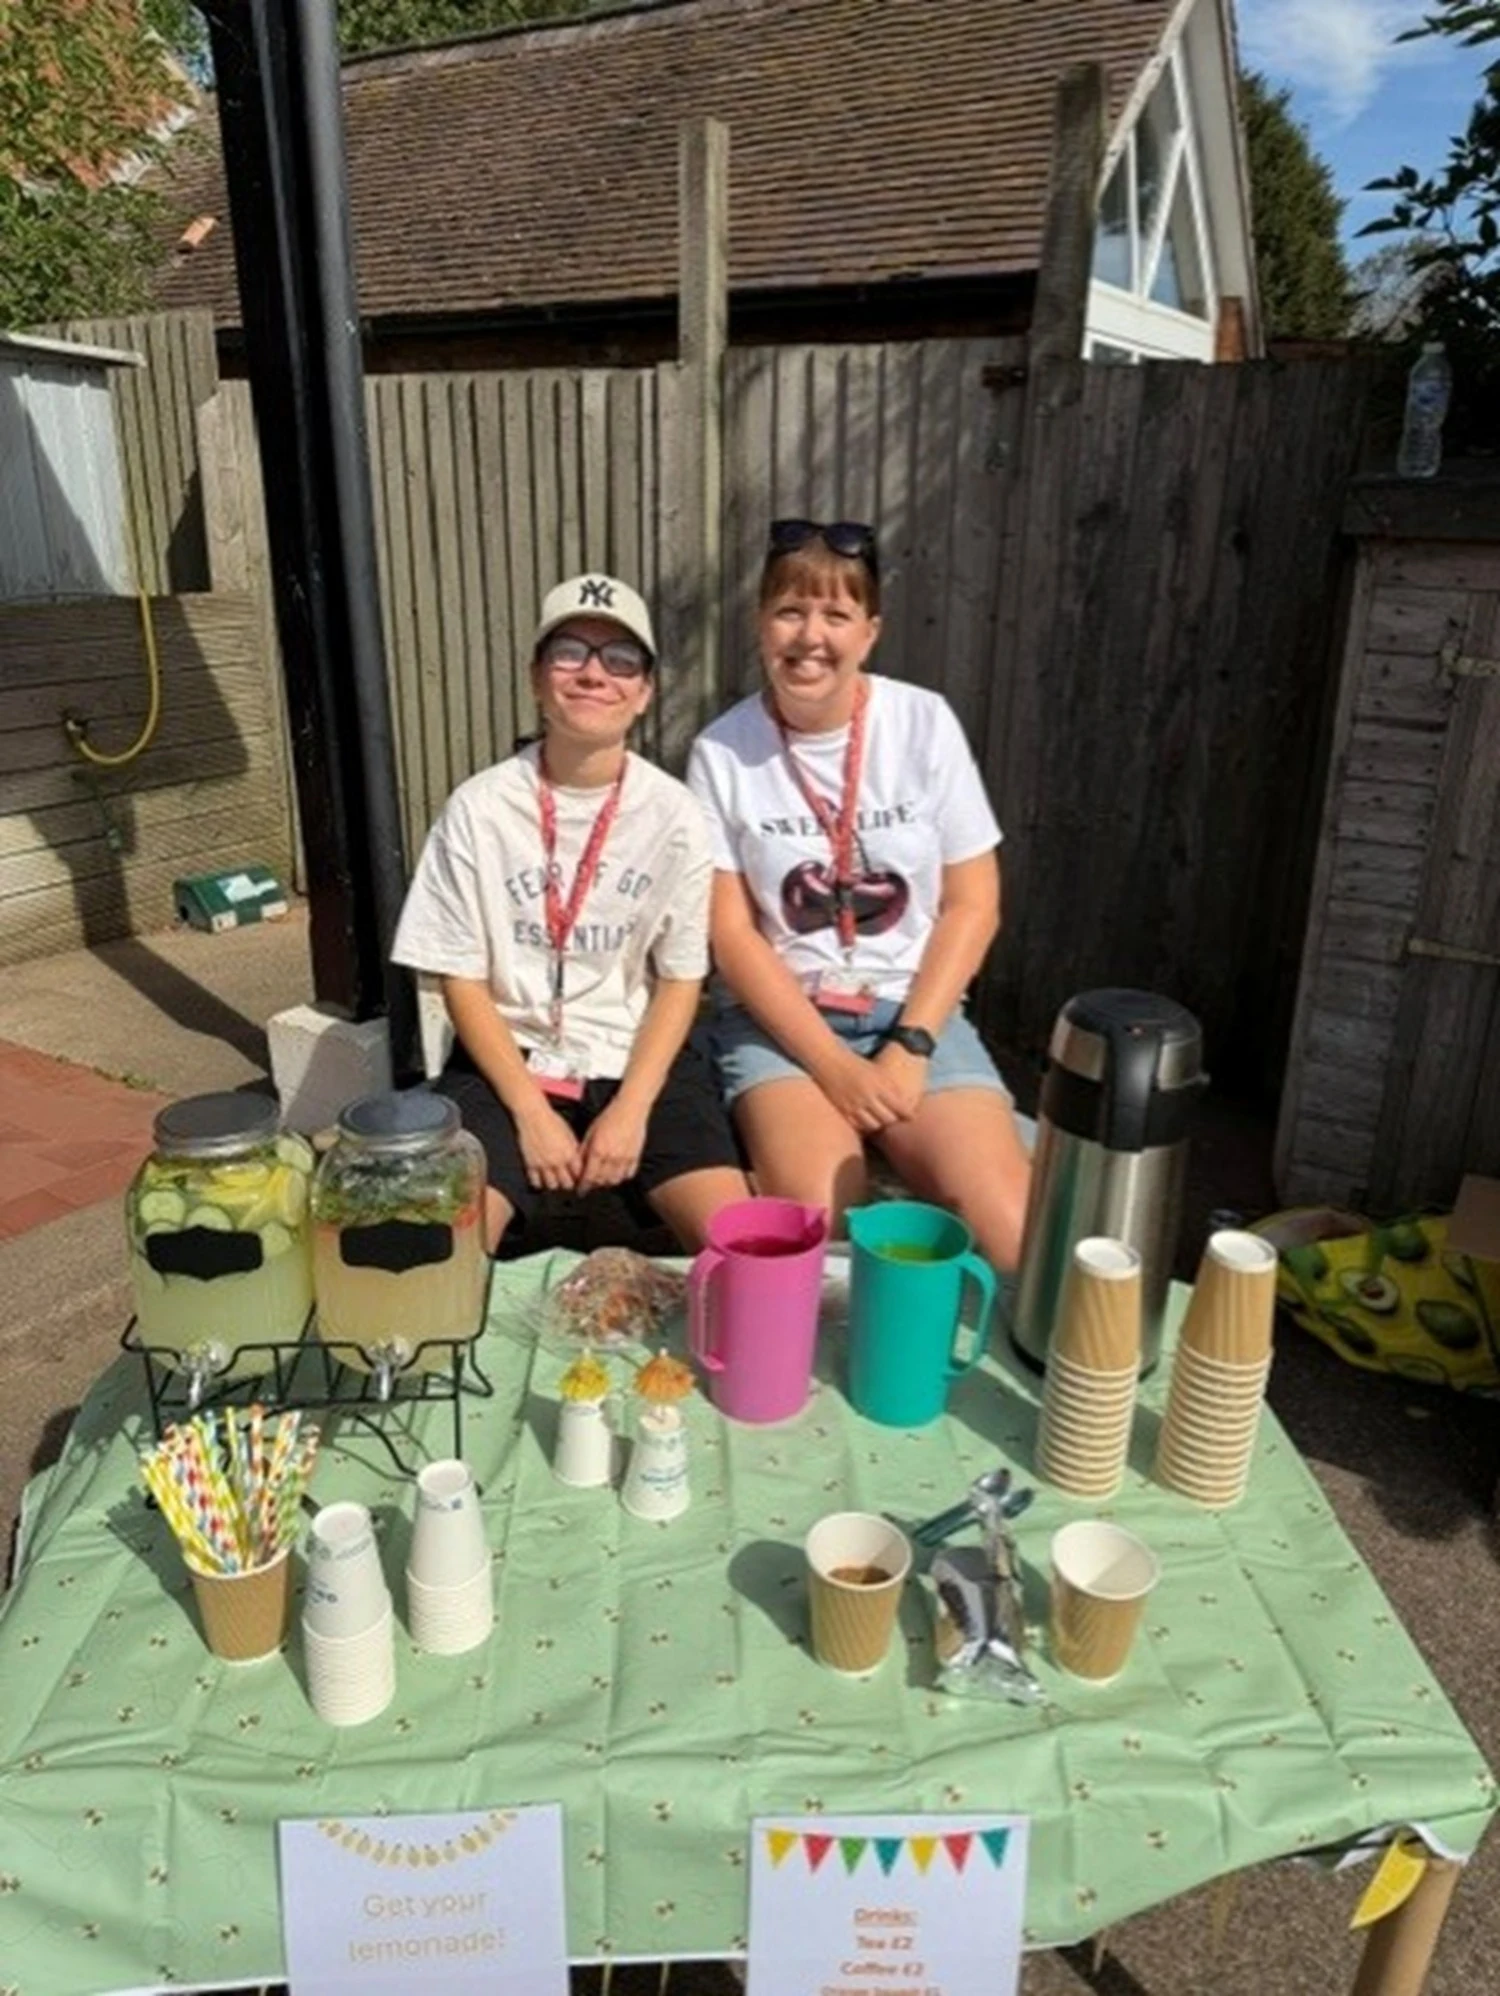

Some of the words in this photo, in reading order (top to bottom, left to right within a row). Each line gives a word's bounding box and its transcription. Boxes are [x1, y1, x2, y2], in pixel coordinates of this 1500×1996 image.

[579, 579, 615, 607] NY
[857, 801, 914, 831] LIFE
[363, 1893, 414, 1917] Get
[415, 1892, 487, 1918] your
[348, 1927, 506, 1962] lemonade!
[840, 1961, 898, 1976] Coffee
